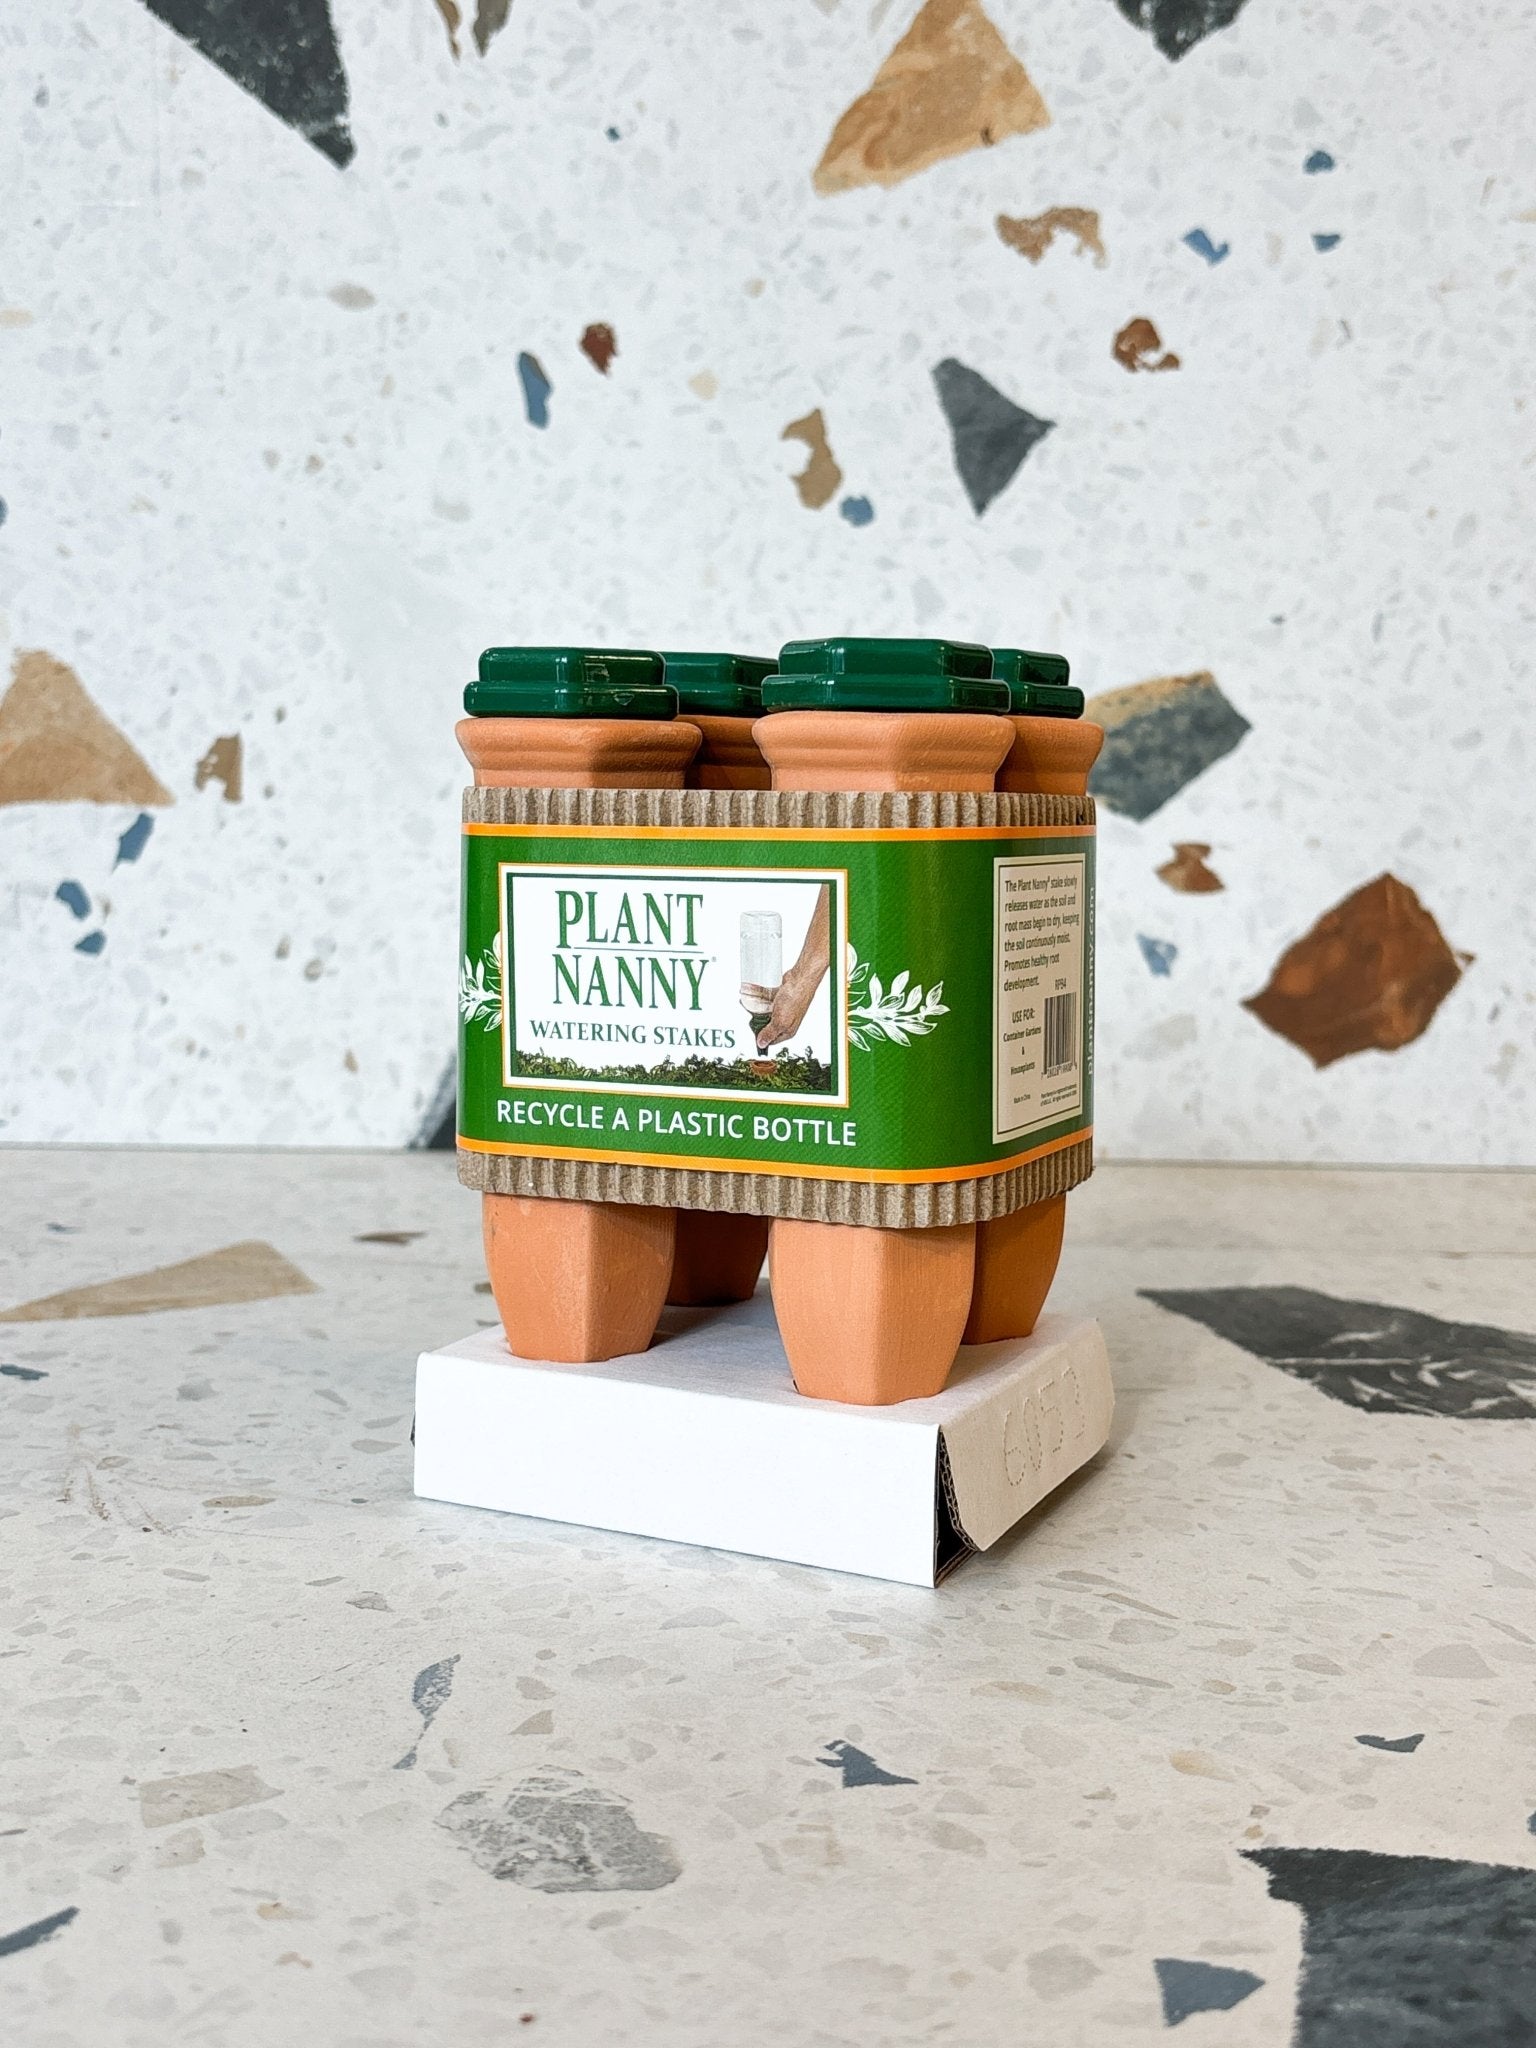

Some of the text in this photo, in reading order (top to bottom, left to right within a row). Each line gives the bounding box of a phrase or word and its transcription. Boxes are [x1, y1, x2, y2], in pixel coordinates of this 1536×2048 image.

[1005, 880, 1016, 892] The
[1018, 879, 1031, 891] Plant
[1005, 899, 1028, 912] releases
[1029, 898, 1043, 910] water
[1044, 898, 1049, 908] as
[1050, 896, 1058, 907] the
[1059, 894, 1067, 907] soil
[555, 890, 704, 948] PLANT
[1005, 920, 1018, 932] root
[1019, 919, 1032, 930] mass
[1033, 916, 1046, 931] begin
[1047, 917, 1051, 927] to
[1004, 939, 1015, 952] the
[1016, 937, 1025, 951] soil
[1004, 953, 1060, 971] Promotes healthy root
[1012, 1010, 1022, 1024] USE
[530, 1019, 736, 1049] WATERING STAKES
[497, 1099, 857, 1147] RECYCLE A PLASTIC BOTTLE
